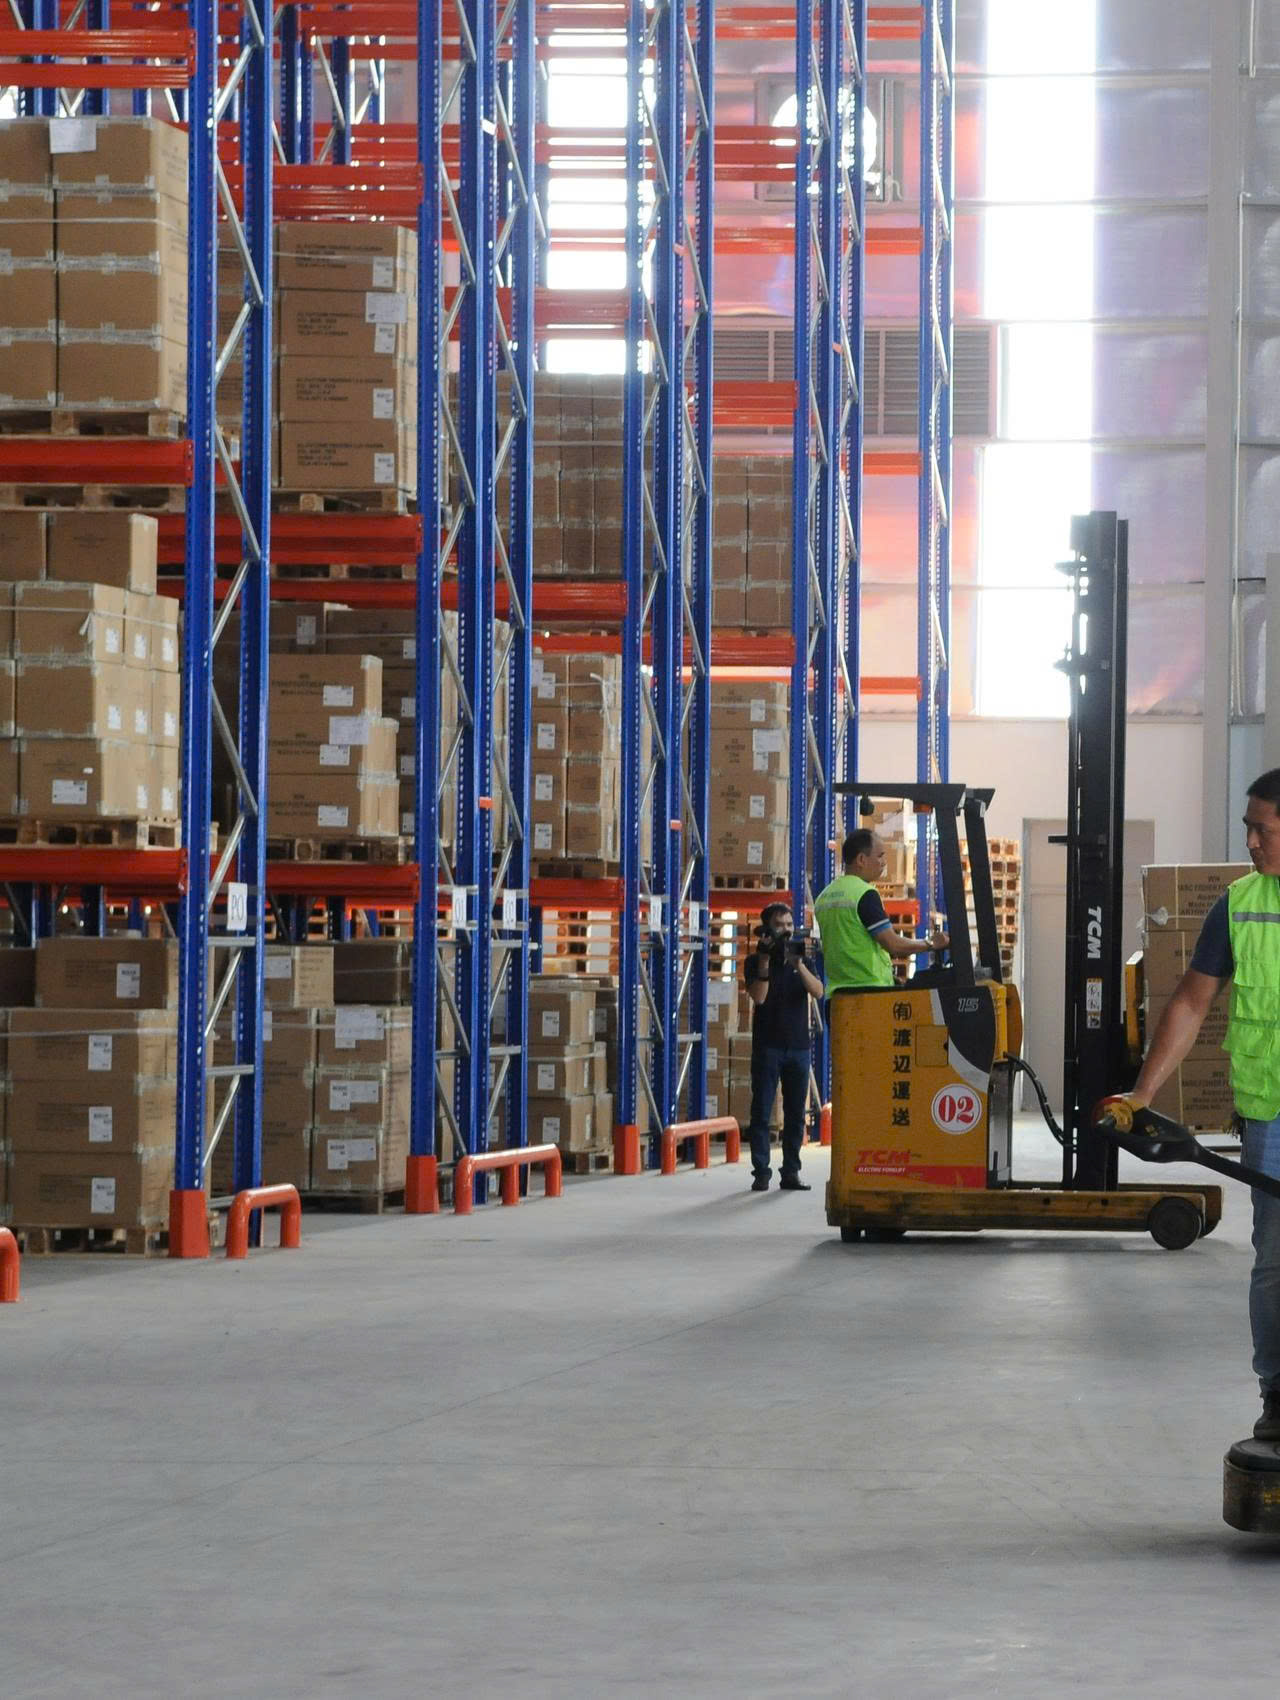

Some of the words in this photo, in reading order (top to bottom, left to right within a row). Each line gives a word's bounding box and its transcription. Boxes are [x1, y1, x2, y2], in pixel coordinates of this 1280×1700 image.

[1087, 906, 1102, 959] TCM
[938, 1094, 975, 1124] 02
[857, 1150, 910, 1164] TCM
